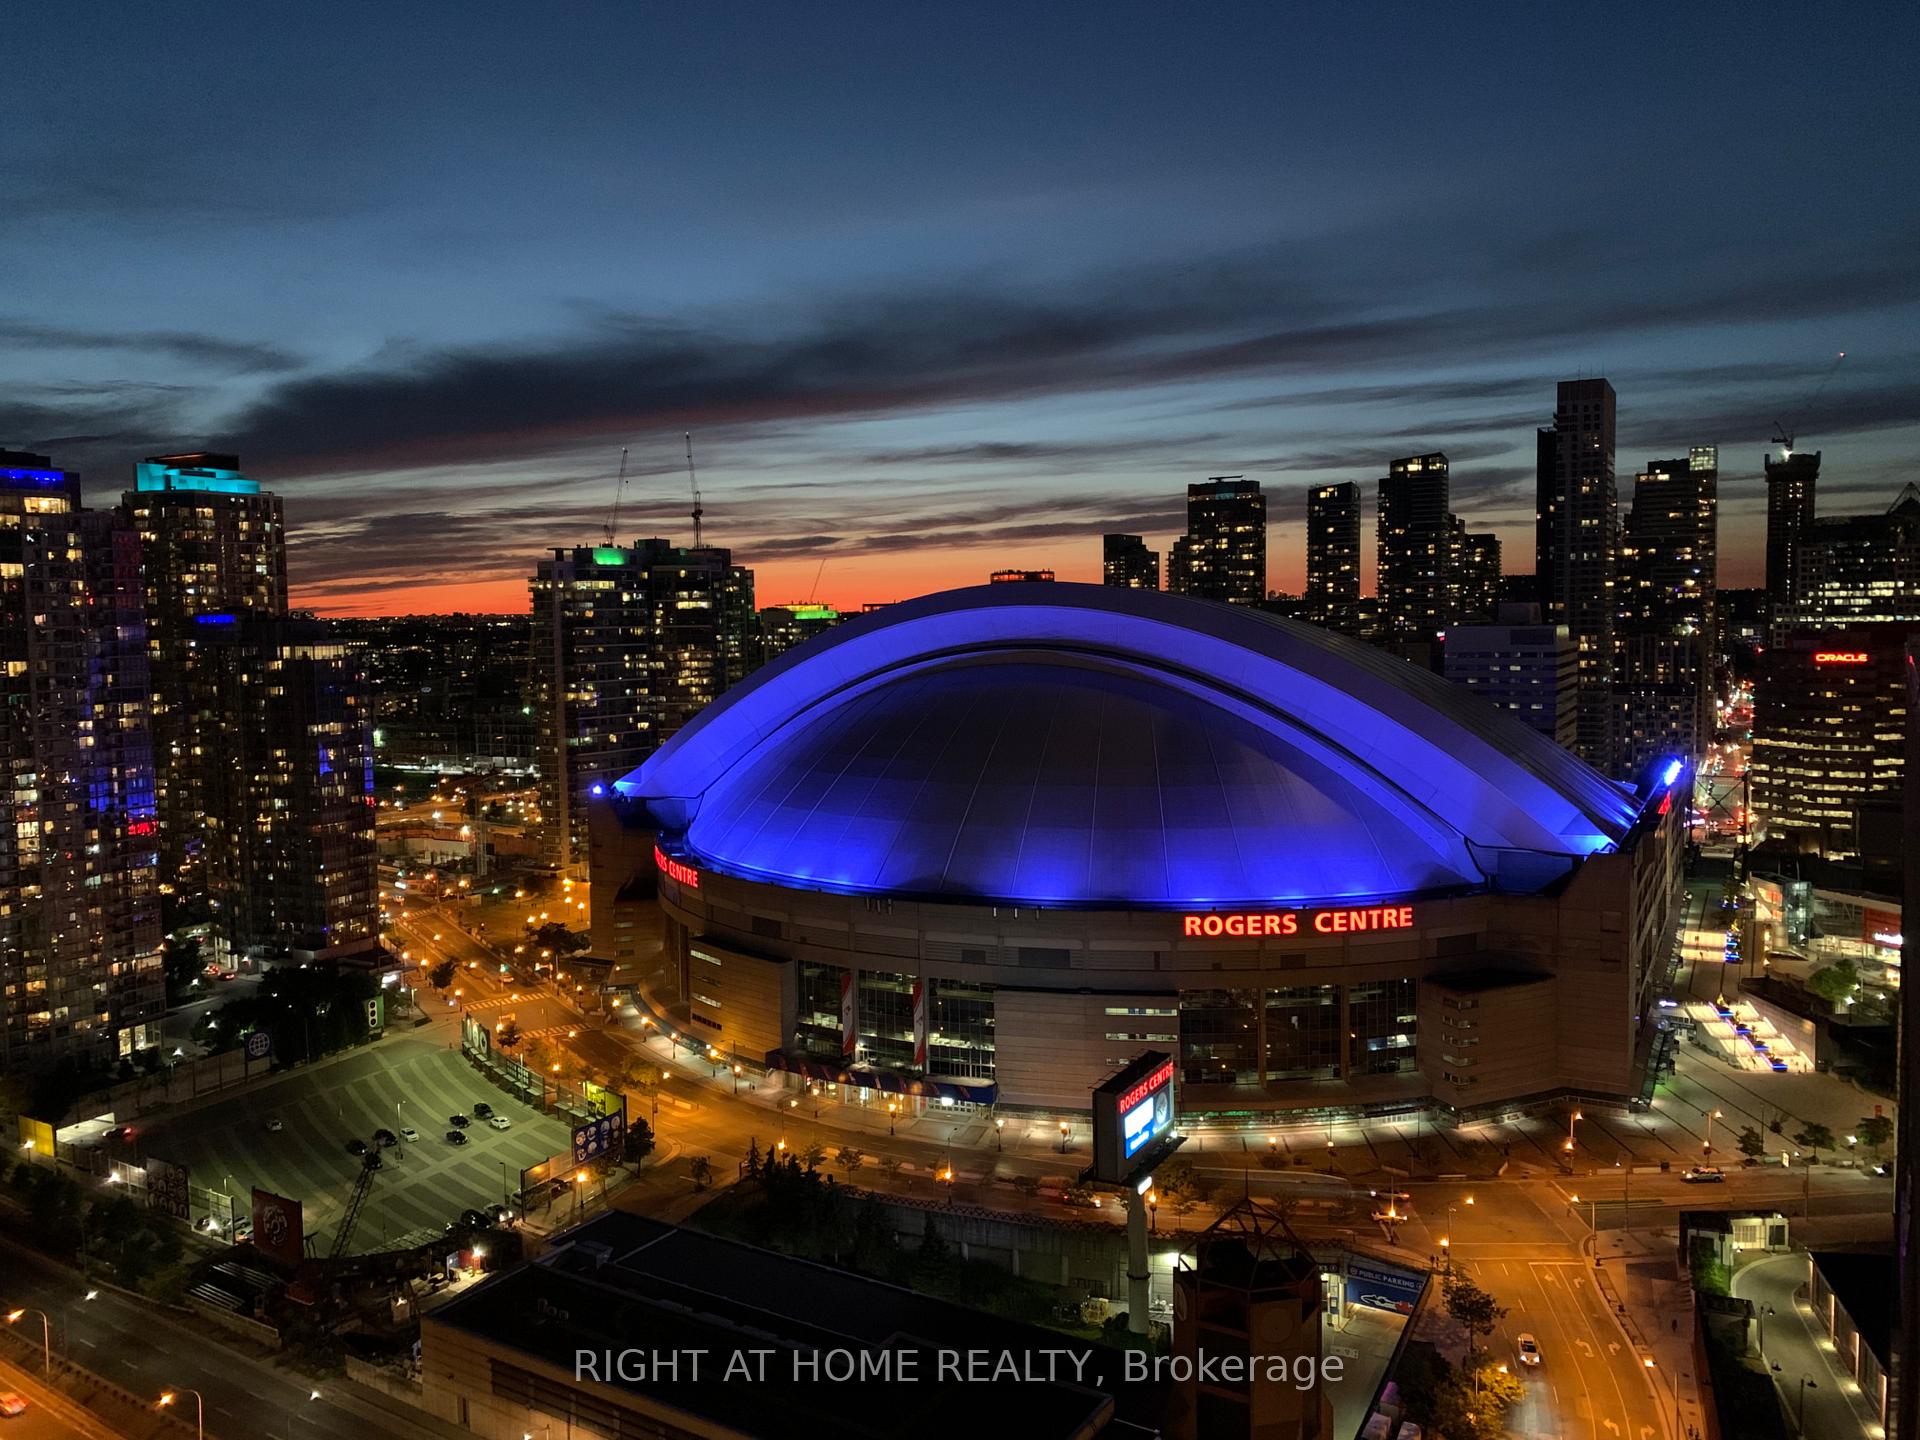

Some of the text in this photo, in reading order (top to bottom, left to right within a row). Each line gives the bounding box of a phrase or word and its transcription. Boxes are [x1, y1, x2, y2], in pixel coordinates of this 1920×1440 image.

[1815, 653, 1868, 662] ORACLE
[668, 860, 698, 888] CENTRE
[1184, 907, 1413, 936] ROGERS CENTRE
[1120, 1061, 1174, 1113] ROGERS CENTRE
[1359, 1269, 1415, 1288] PUBLIC PARKING
